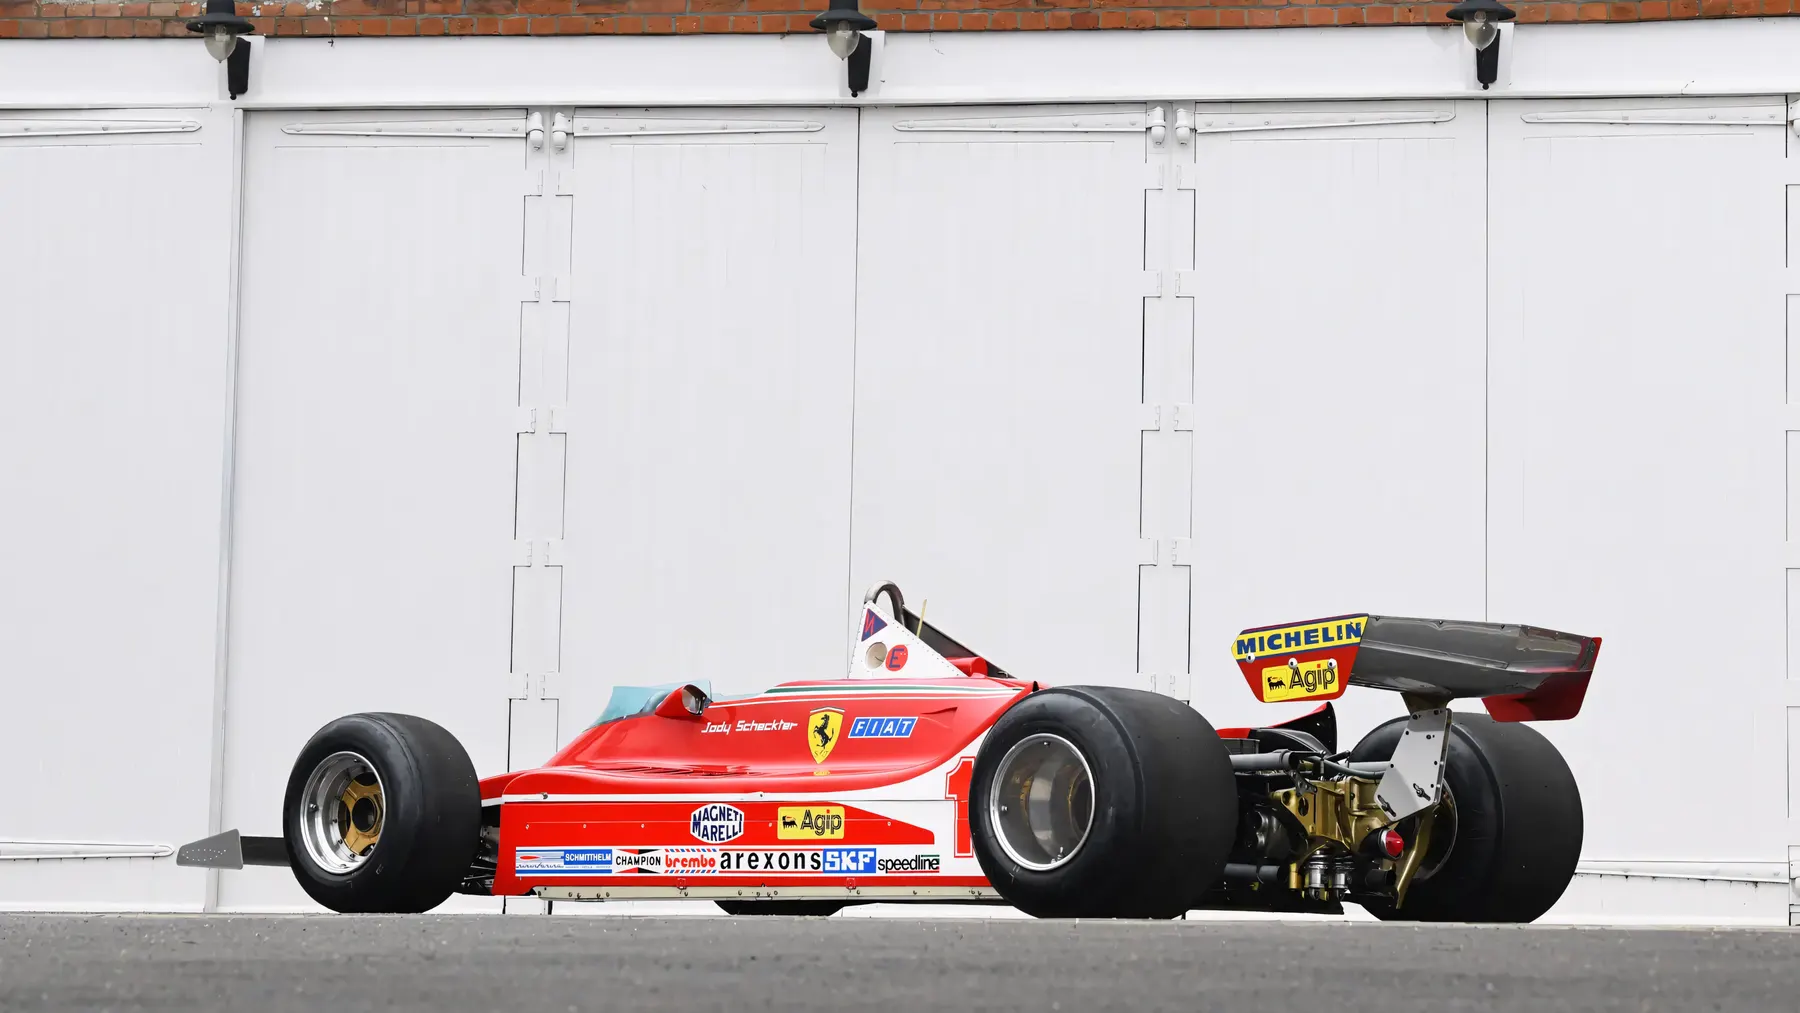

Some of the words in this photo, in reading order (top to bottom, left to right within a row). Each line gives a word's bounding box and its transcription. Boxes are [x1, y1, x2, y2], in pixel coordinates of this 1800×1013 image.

[1236, 622, 1361, 655] MICHELIN
[889, 648, 904, 668] E
[1289, 663, 1335, 692] Agip
[701, 721, 731, 735] Jody
[735, 719, 798, 732] Scheckter
[855, 720, 911, 734] FIAT
[692, 805, 743, 823] MAGNETI
[800, 808, 842, 836] Agip
[692, 820, 742, 842] MARELLI
[565, 853, 612, 862] SCHMITTHELM
[615, 855, 661, 866] CHAMPION
[665, 854, 716, 868] brembo
[720, 851, 821, 871] arexons
[824, 850, 875, 872] SKF
[877, 854, 940, 874] speedline
